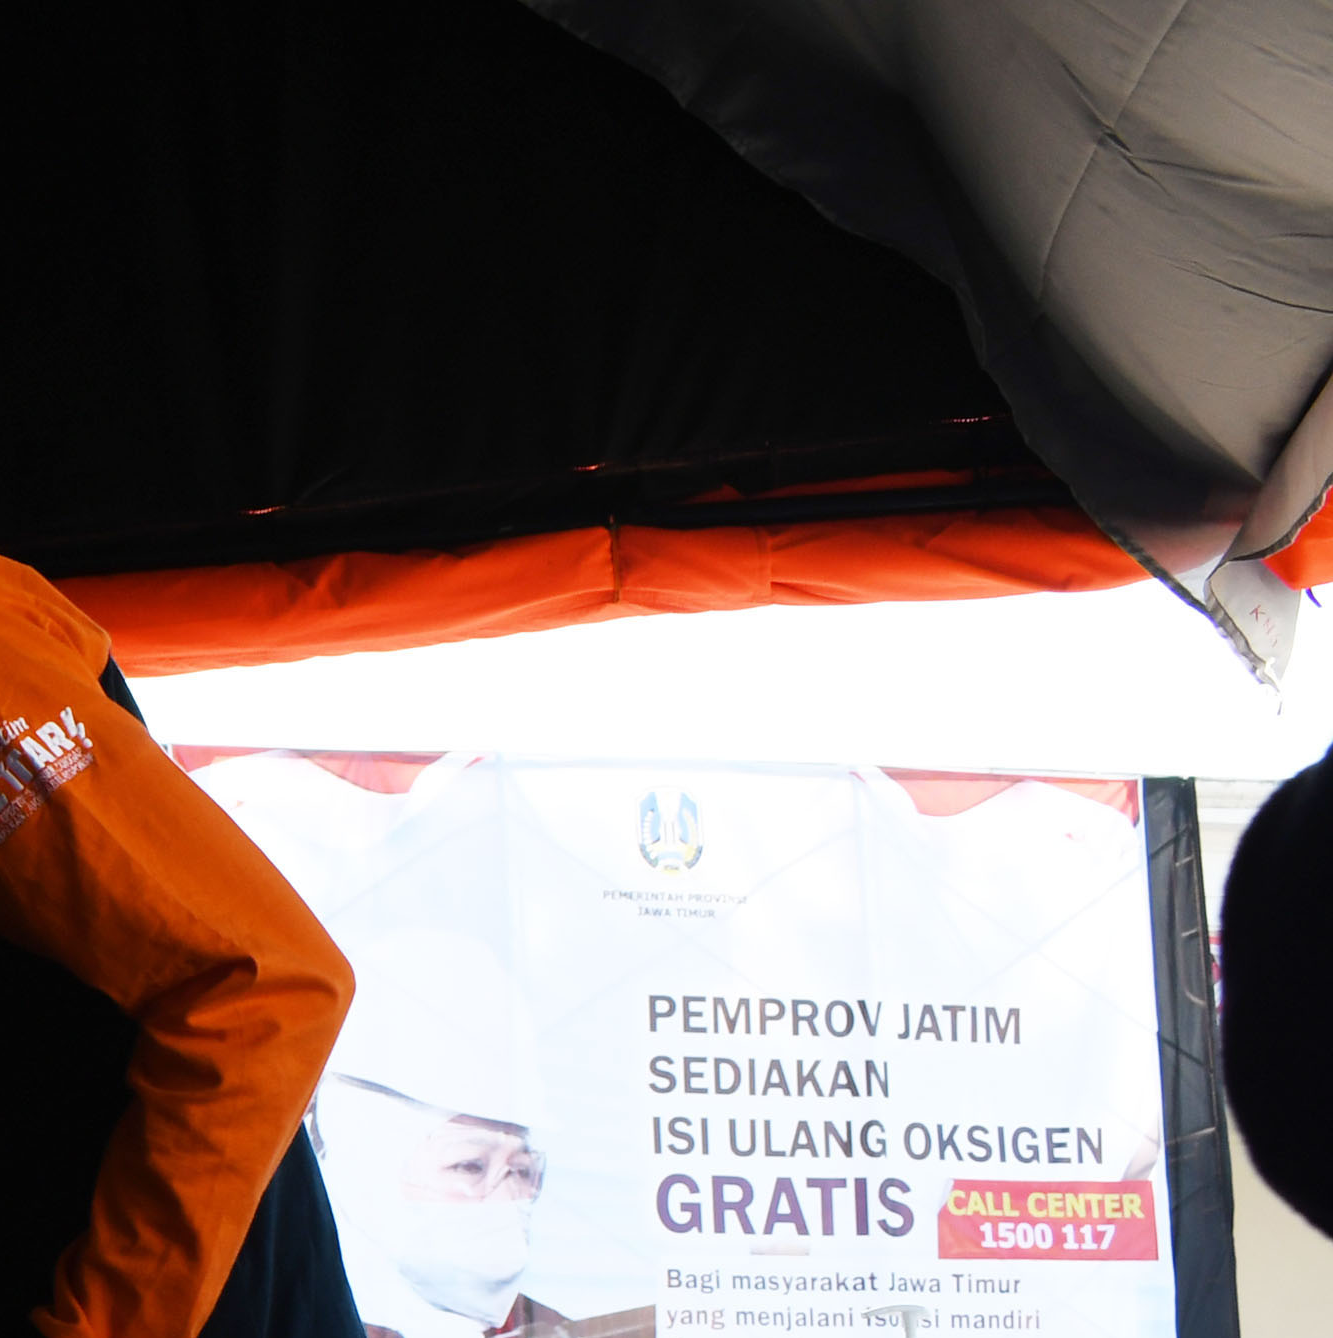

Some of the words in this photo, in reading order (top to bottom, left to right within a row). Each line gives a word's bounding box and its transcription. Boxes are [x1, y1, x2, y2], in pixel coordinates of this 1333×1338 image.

[603, 890, 683, 902] PEMERINTAH
[638, 907, 671, 917] JAWA
[677, 908, 716, 919] TIMUR
[649, 995, 882, 1038] PEMPROV
[898, 1003, 1021, 1044] JATIM
[649, 1055, 889, 1099] SEDIAKAN
[653, 1116, 709, 1155] ISI
[729, 1119, 887, 1159] ULANG
[904, 1122, 1103, 1165] OKSIGEN
[656, 1173, 915, 1238] GRATIS
[946, 1190, 1020, 1217] CALL
[1027, 1192, 1145, 1219] CENTER
[979, 1222, 1054, 1250] 1500
[1062, 1223, 1116, 1250] 117
[667, 1269, 720, 1293] Bagi
[732, 1272, 878, 1295] masyarakat
[888, 1272, 941, 1293] Jawa
[952, 1274, 1021, 1294] Timur
[666, 1309, 726, 1329] yang
[735, 1307, 854, 1331] menjalani
[951, 1310, 1041, 1330] mandiri
